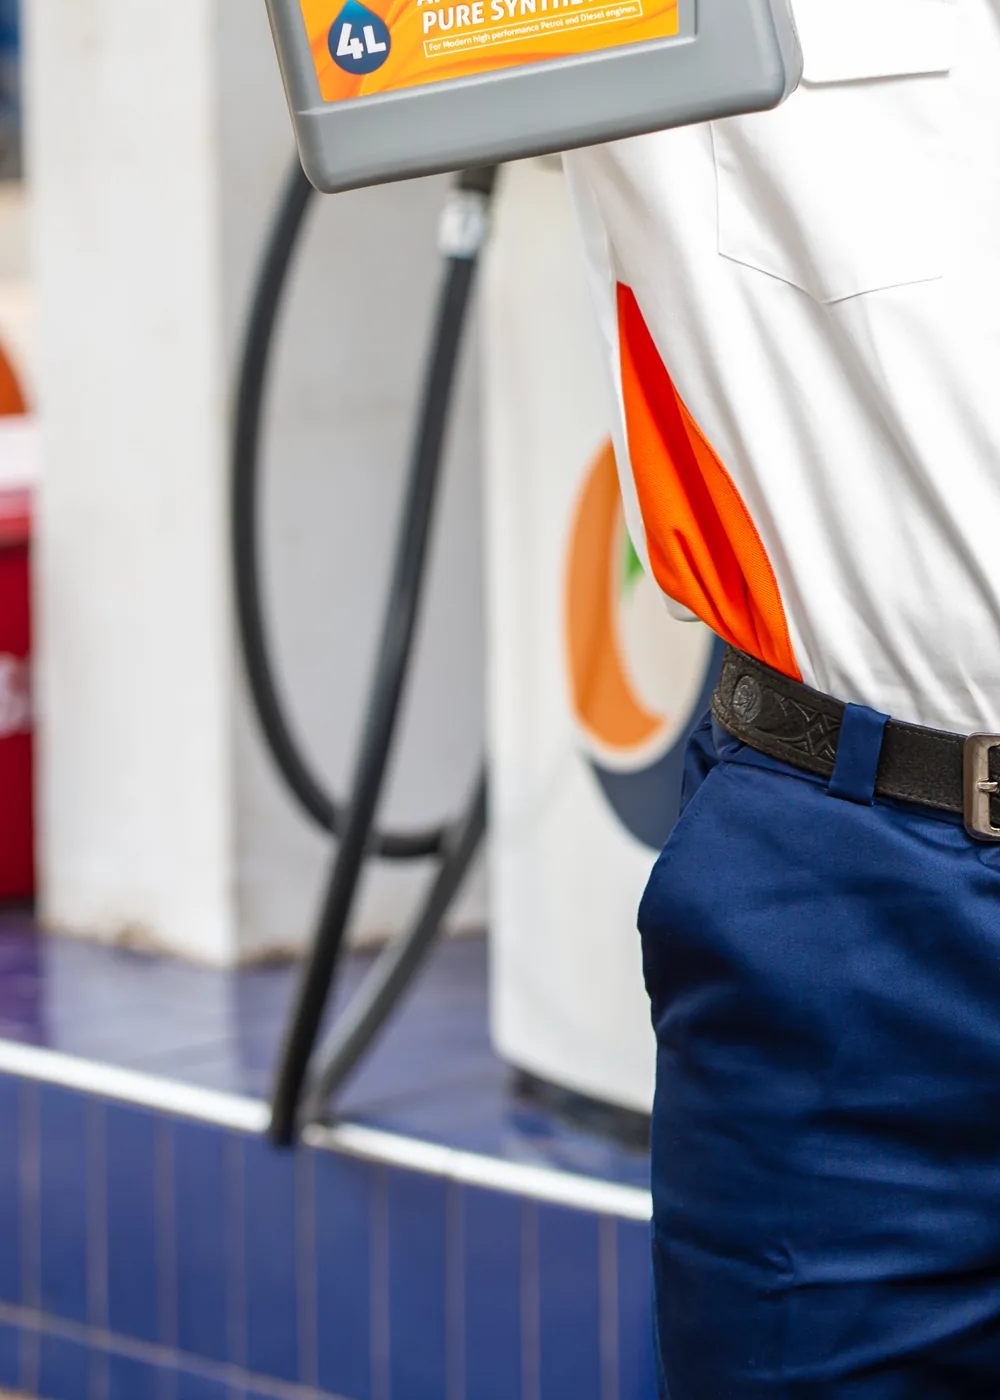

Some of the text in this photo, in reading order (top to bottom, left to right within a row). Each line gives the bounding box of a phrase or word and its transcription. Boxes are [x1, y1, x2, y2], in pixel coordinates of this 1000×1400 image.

[423, 0, 485, 34] PURE
[429, 5, 638, 52] For Modern high performance Petrol and Diesel engines.
[336, 22, 387, 60] 4L
